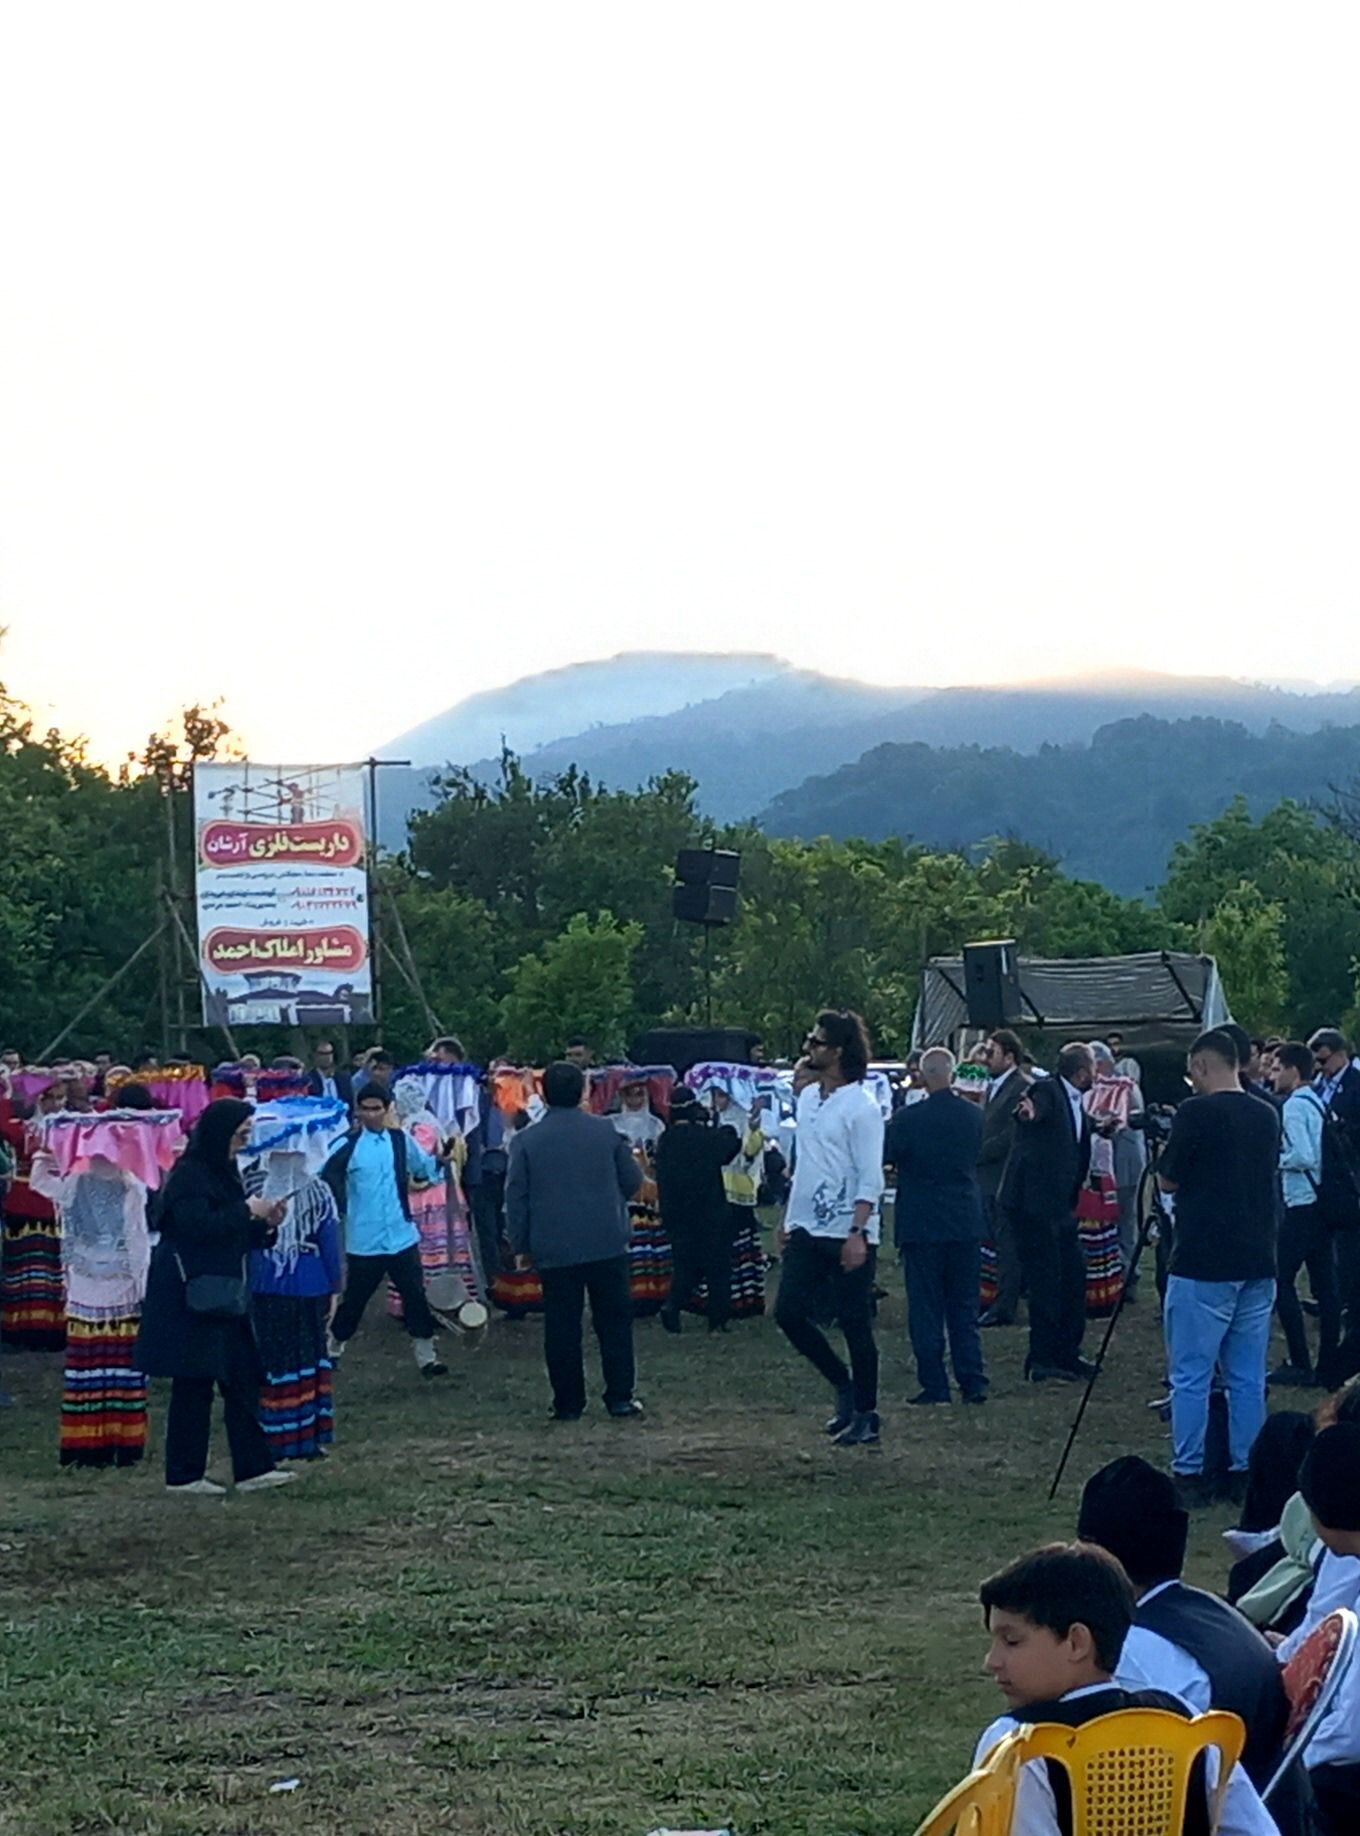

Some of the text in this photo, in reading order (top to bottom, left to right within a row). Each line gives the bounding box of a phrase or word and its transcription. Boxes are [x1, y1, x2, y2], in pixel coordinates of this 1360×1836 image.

[249, 831, 290, 858] فلزی
[213, 936, 352, 964] مشاور املاک احمد
